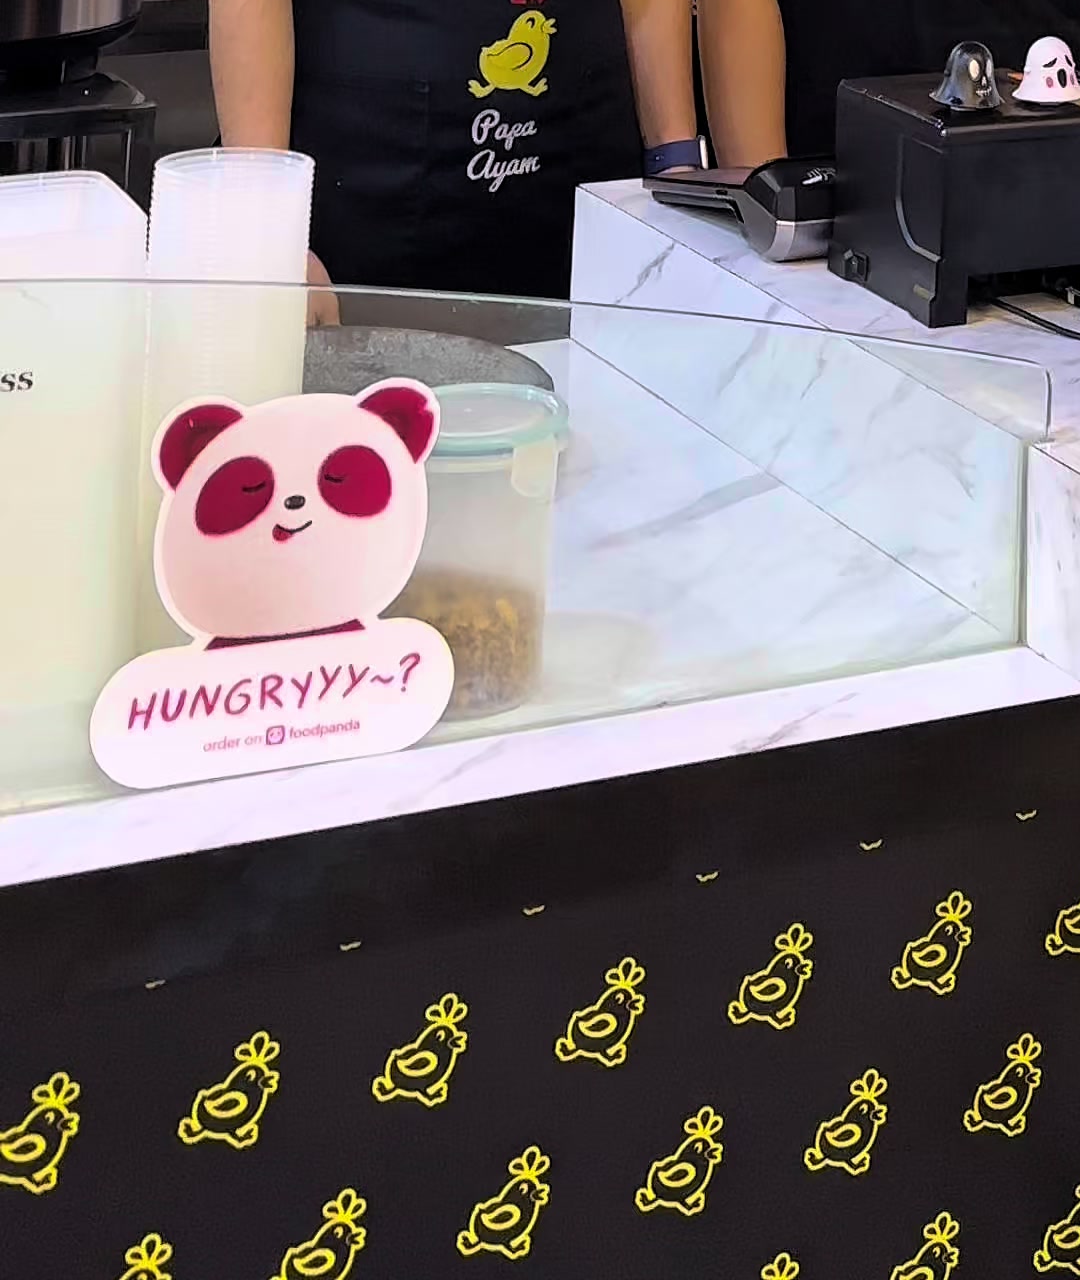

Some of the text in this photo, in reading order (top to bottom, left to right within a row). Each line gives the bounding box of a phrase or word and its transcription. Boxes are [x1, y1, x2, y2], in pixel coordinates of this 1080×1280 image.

[472, 108, 537, 151] Papa
[467, 148, 541, 192] Ayam
[127, 652, 420, 730] HUNGRYYY~?
[203, 719, 361, 752] order on foodpanda
